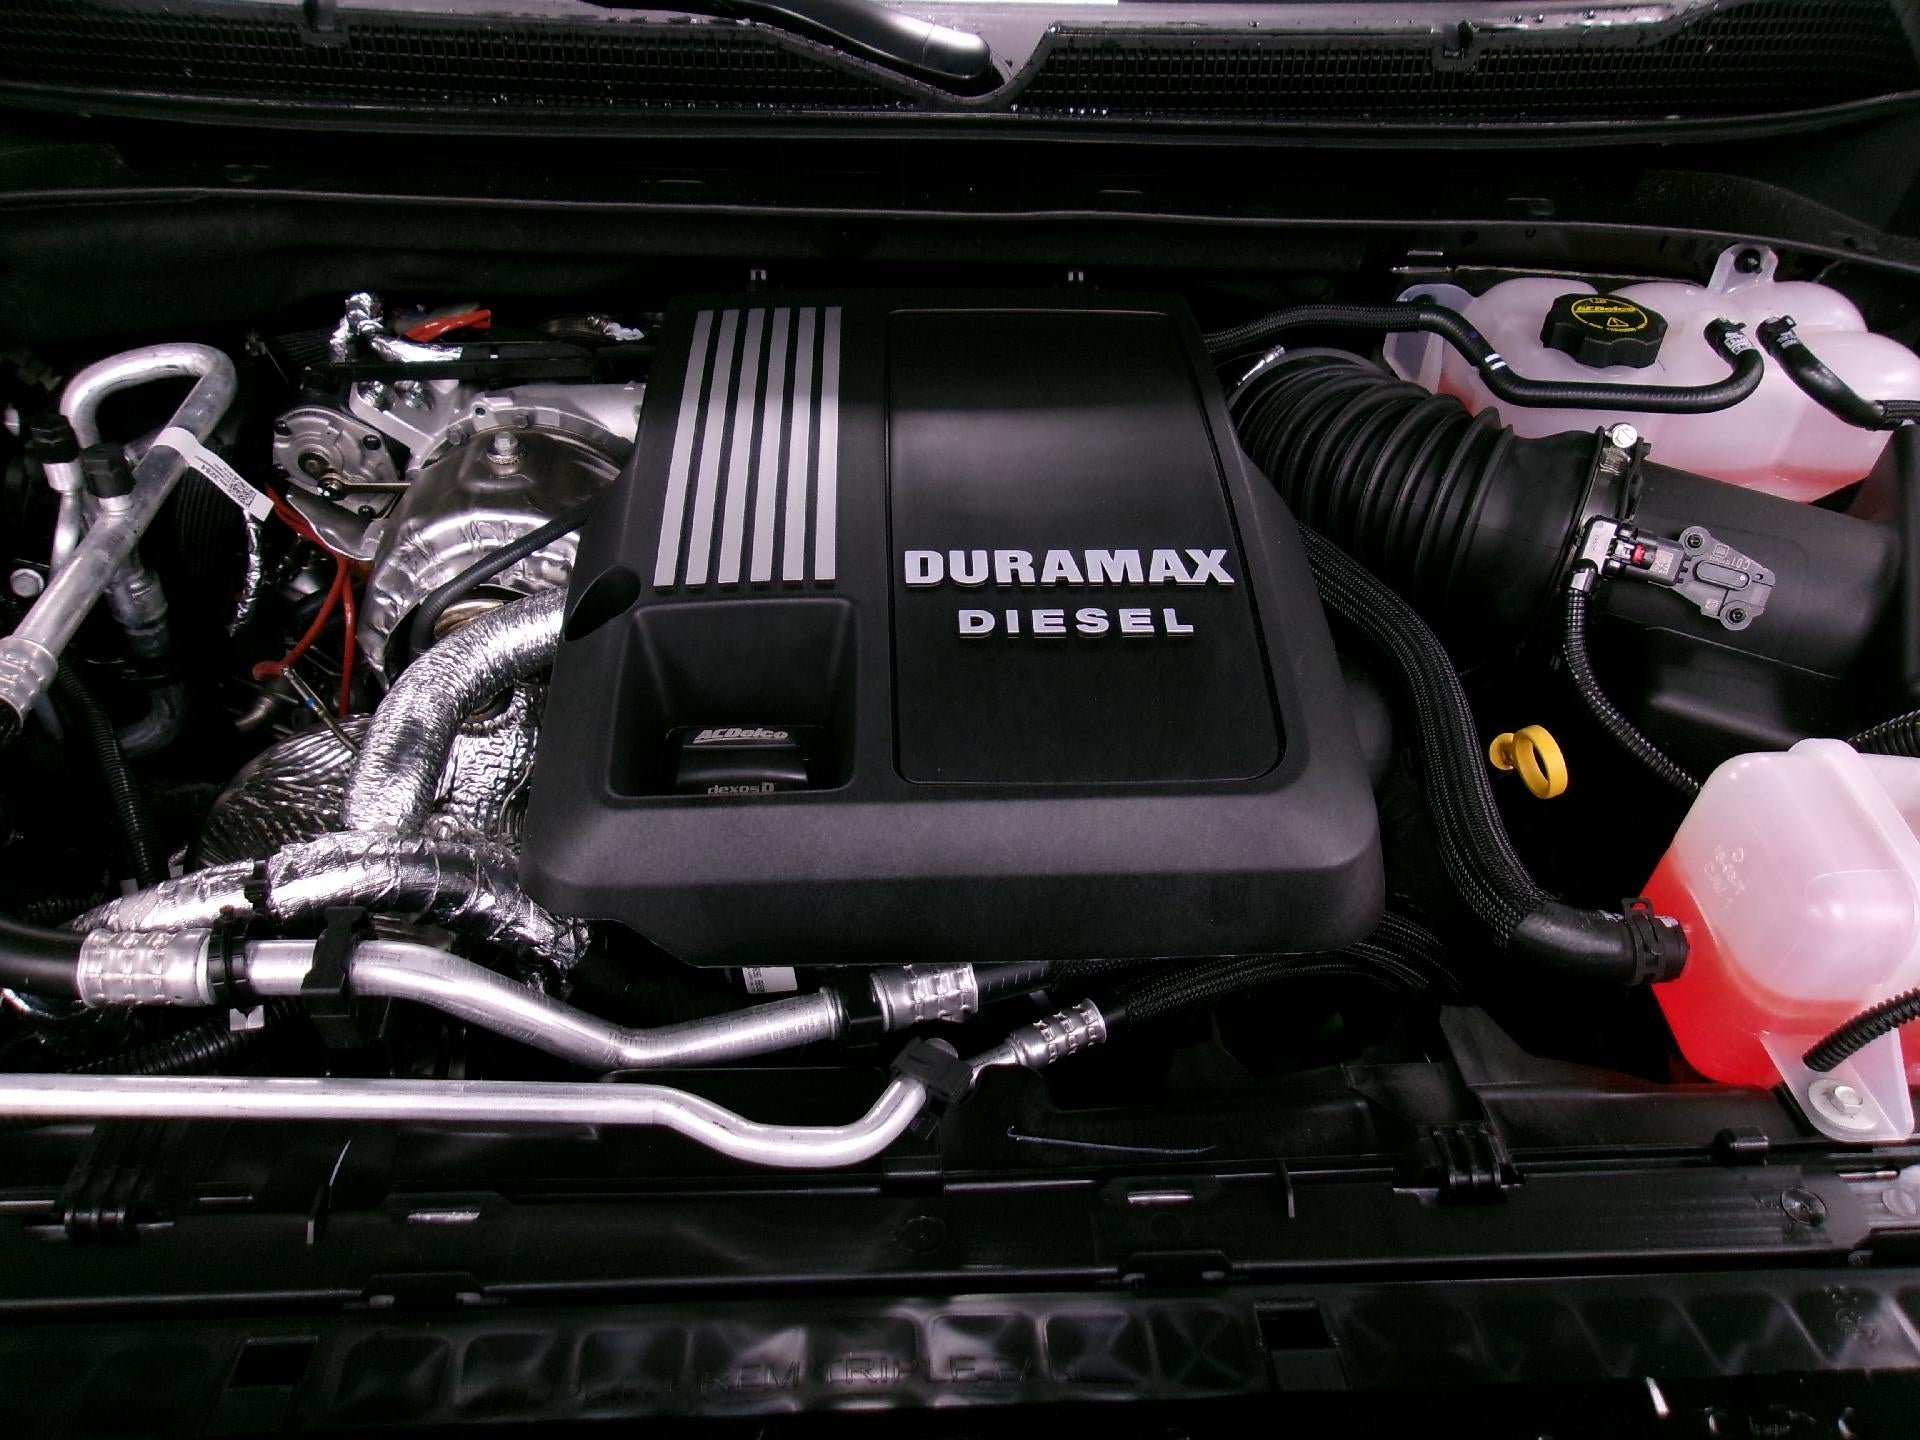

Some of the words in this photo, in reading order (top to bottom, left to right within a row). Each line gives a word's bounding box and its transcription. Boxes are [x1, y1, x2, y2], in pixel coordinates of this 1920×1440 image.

[904, 549, 1236, 587] DURAMAX
[957, 607, 1195, 639] DIESEL
[693, 727, 789, 744] ACDelco
